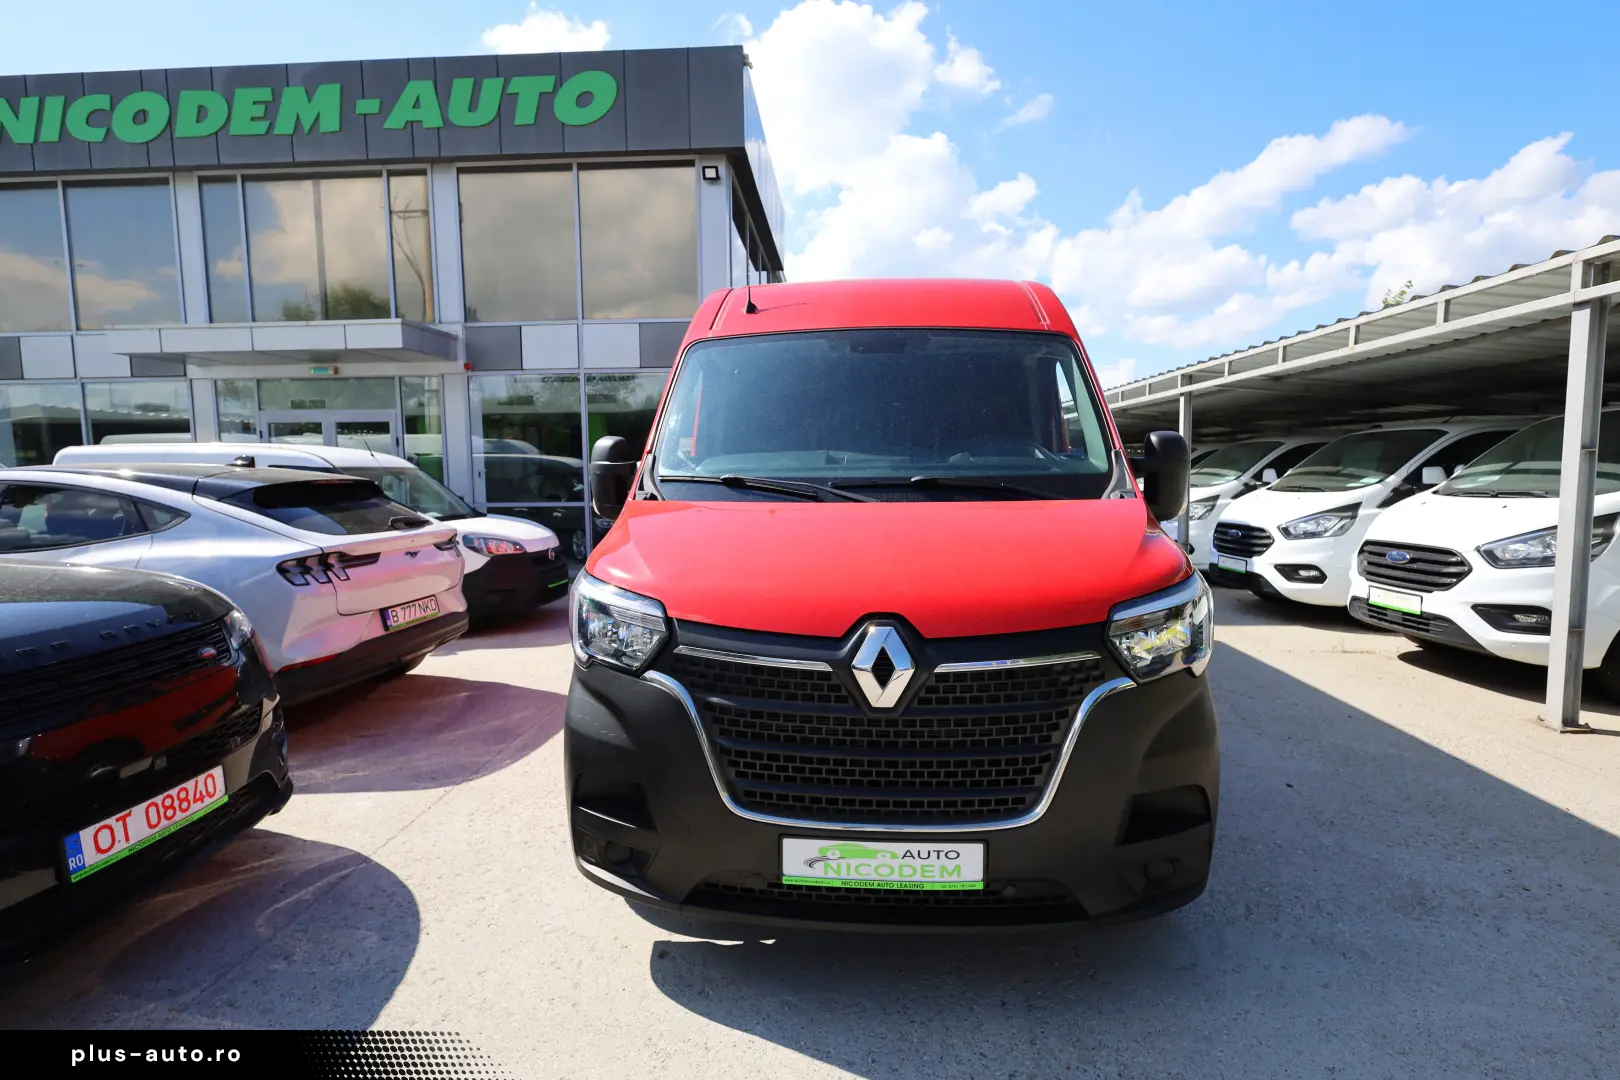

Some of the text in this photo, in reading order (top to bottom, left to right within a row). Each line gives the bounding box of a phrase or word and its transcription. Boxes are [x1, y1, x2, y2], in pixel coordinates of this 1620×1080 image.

[390, 609, 399, 623] B
[400, 604, 417, 620] 777
[418, 598, 437, 615] NKD
[93, 773, 217, 855] OT 08840
[901, 849, 960, 860] AUTO
[68, 855, 84, 871] RO
[823, 862, 961, 879] NICODEM
[841, 880, 925, 890] NICODEM AUTO LEASING
